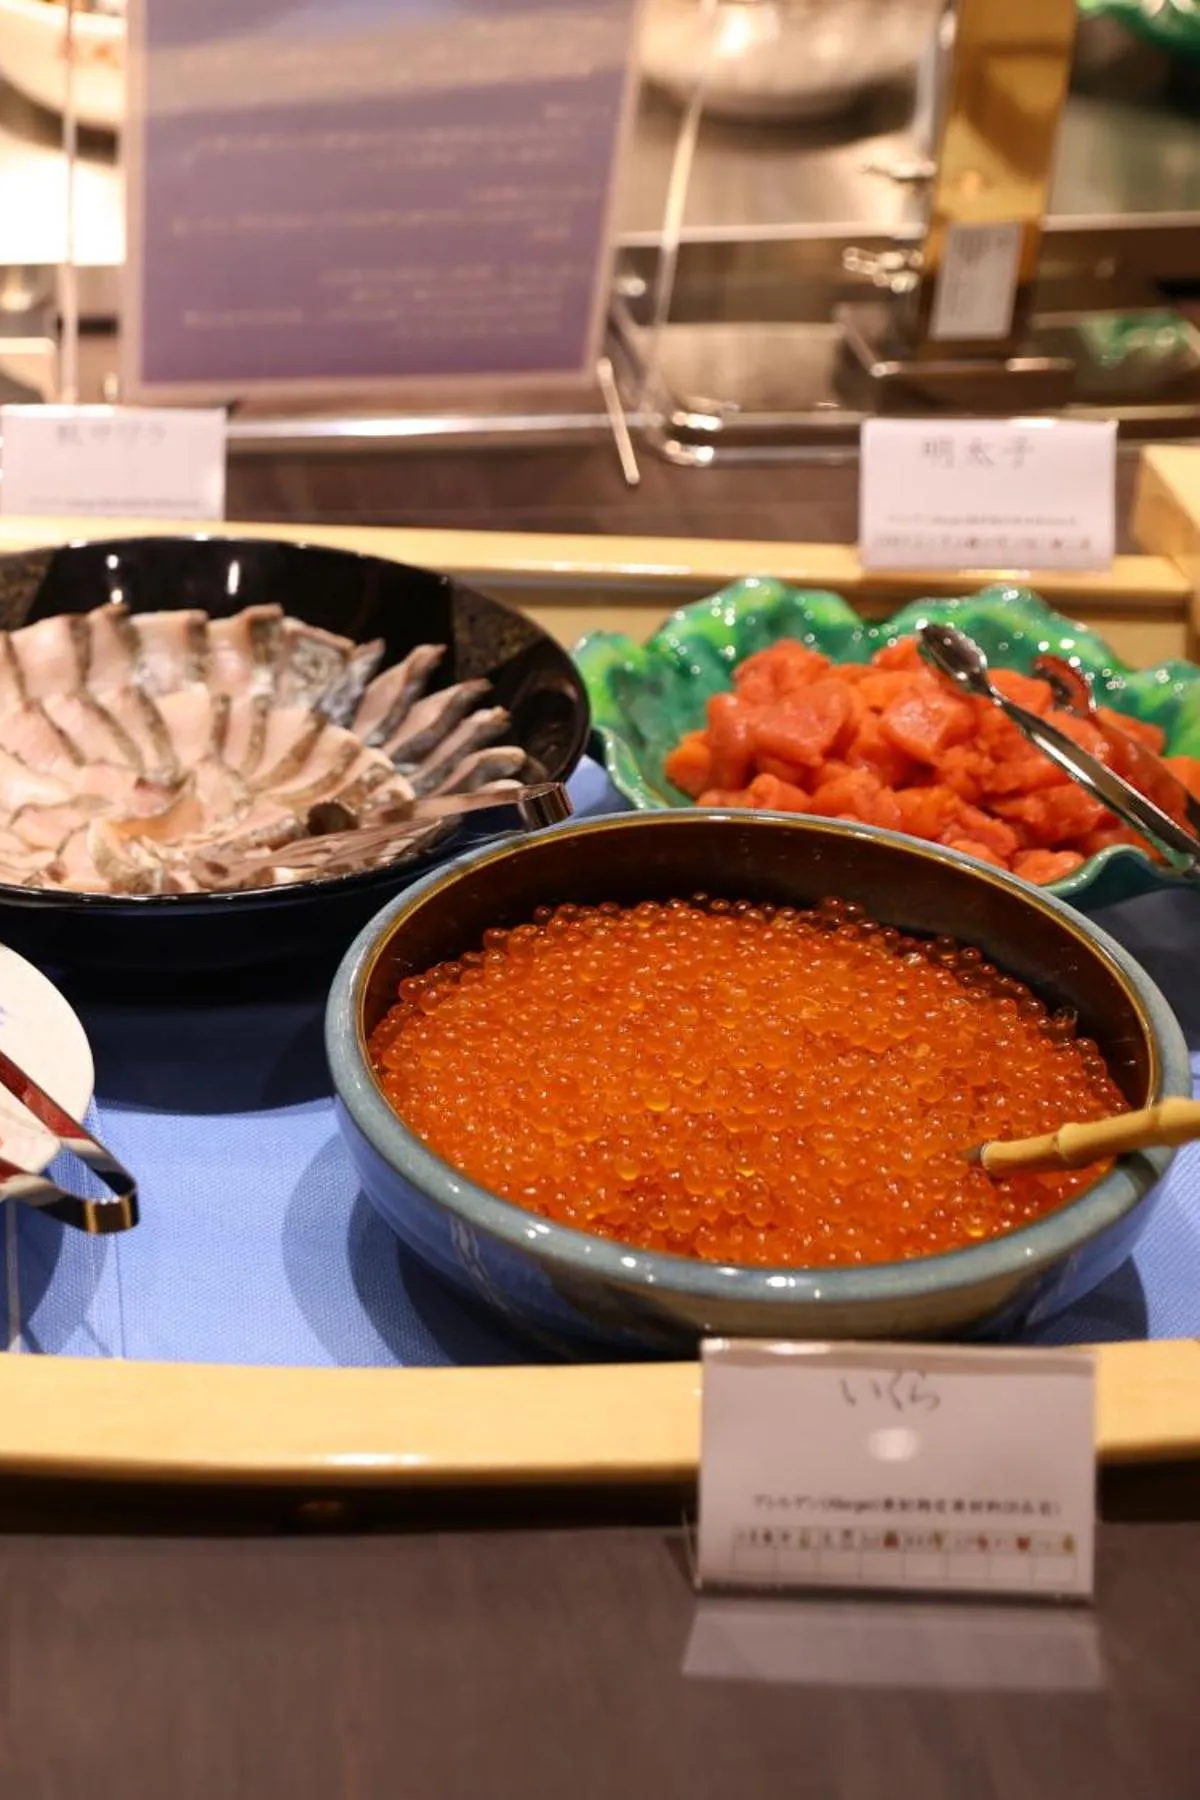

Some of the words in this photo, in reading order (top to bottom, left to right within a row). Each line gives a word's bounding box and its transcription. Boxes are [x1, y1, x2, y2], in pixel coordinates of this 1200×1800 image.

[920, 435, 1036, 471] 明太子
[838, 1367, 942, 1412] いくら
